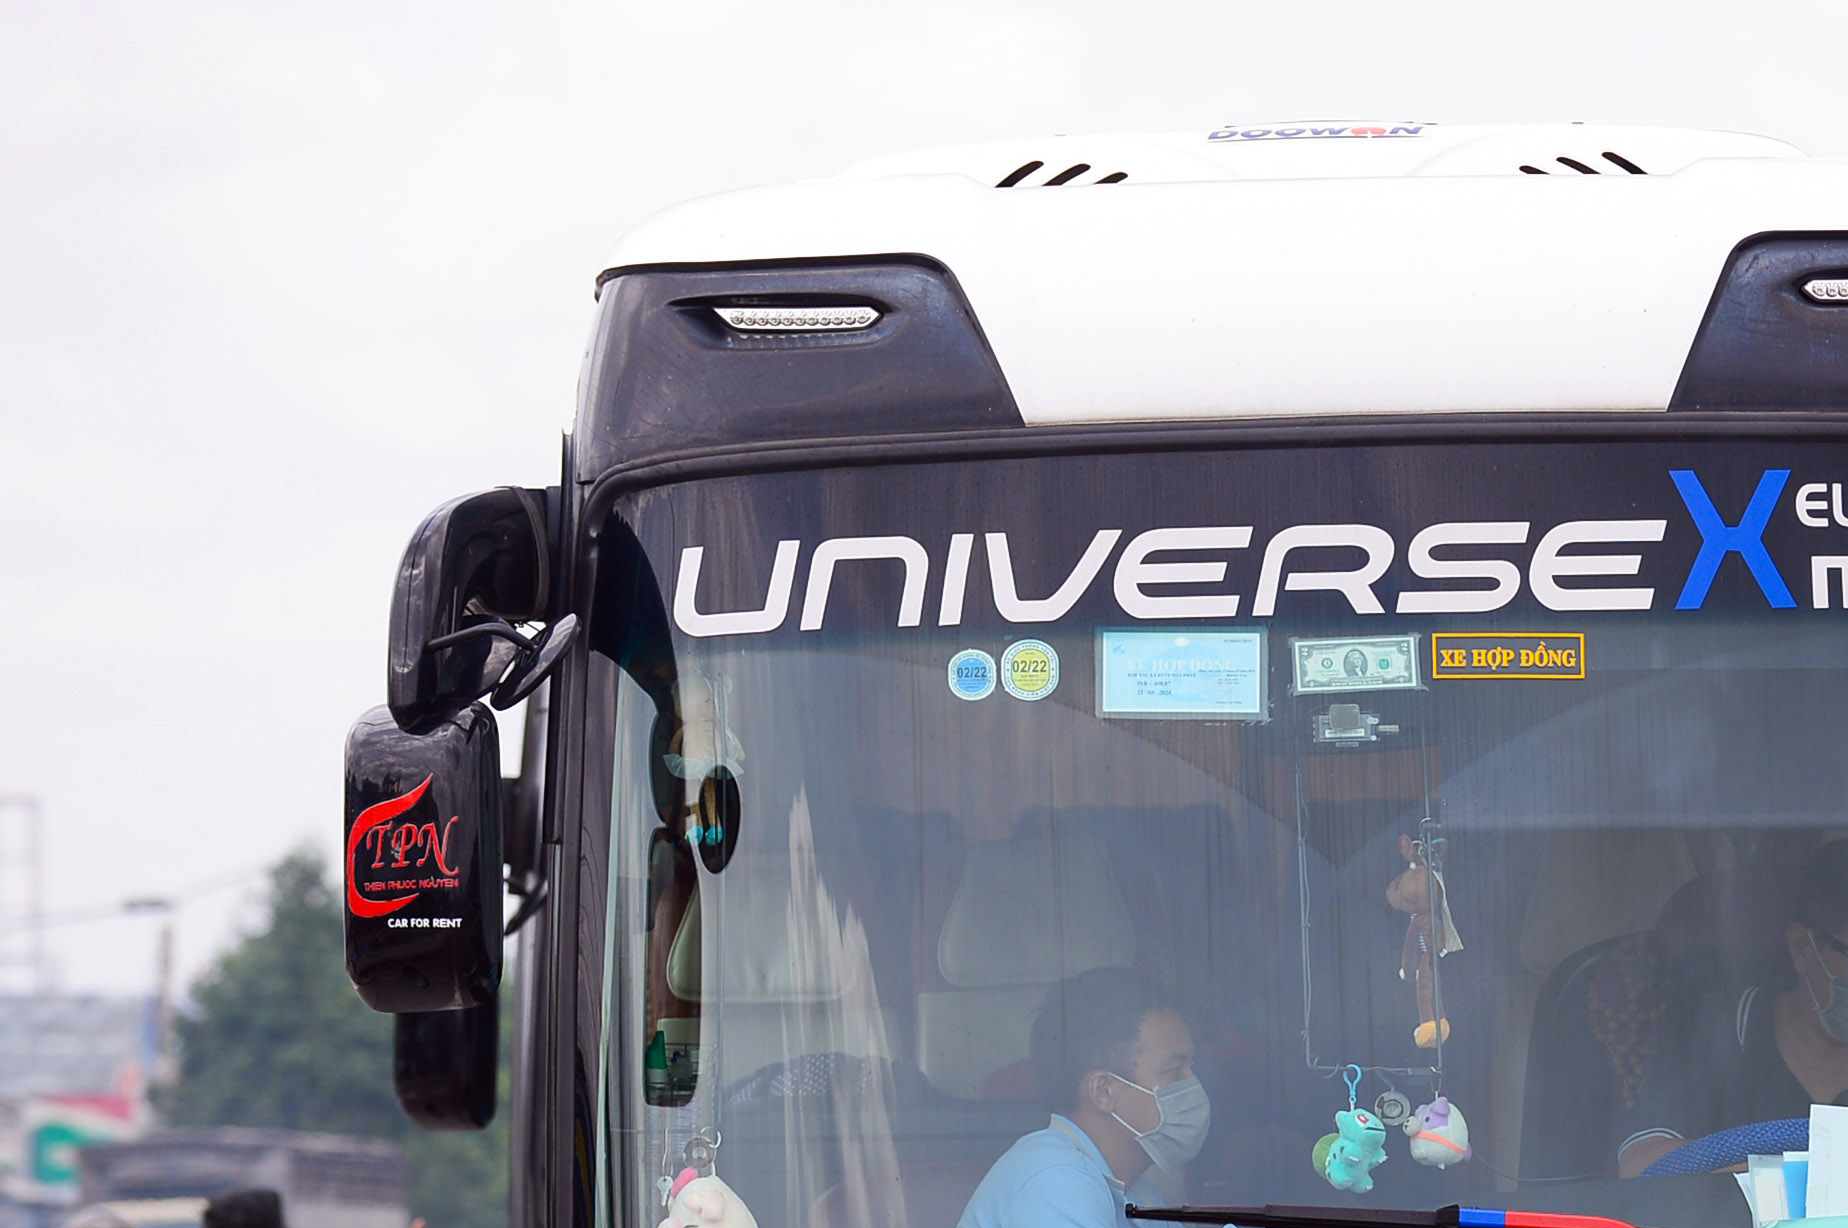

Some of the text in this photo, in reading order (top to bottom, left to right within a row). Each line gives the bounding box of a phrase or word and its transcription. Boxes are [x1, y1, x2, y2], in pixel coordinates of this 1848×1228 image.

[673, 468, 1798, 637] UNIVERSE X
[1012, 660, 1048, 673] 02/22
[1440, 641, 1577, 671] XE HỢP ĐỒNG
[956, 666, 988, 679] 02/22
[366, 816, 460, 876] TPN
[387, 918, 463, 928] CAR FOR RENT
